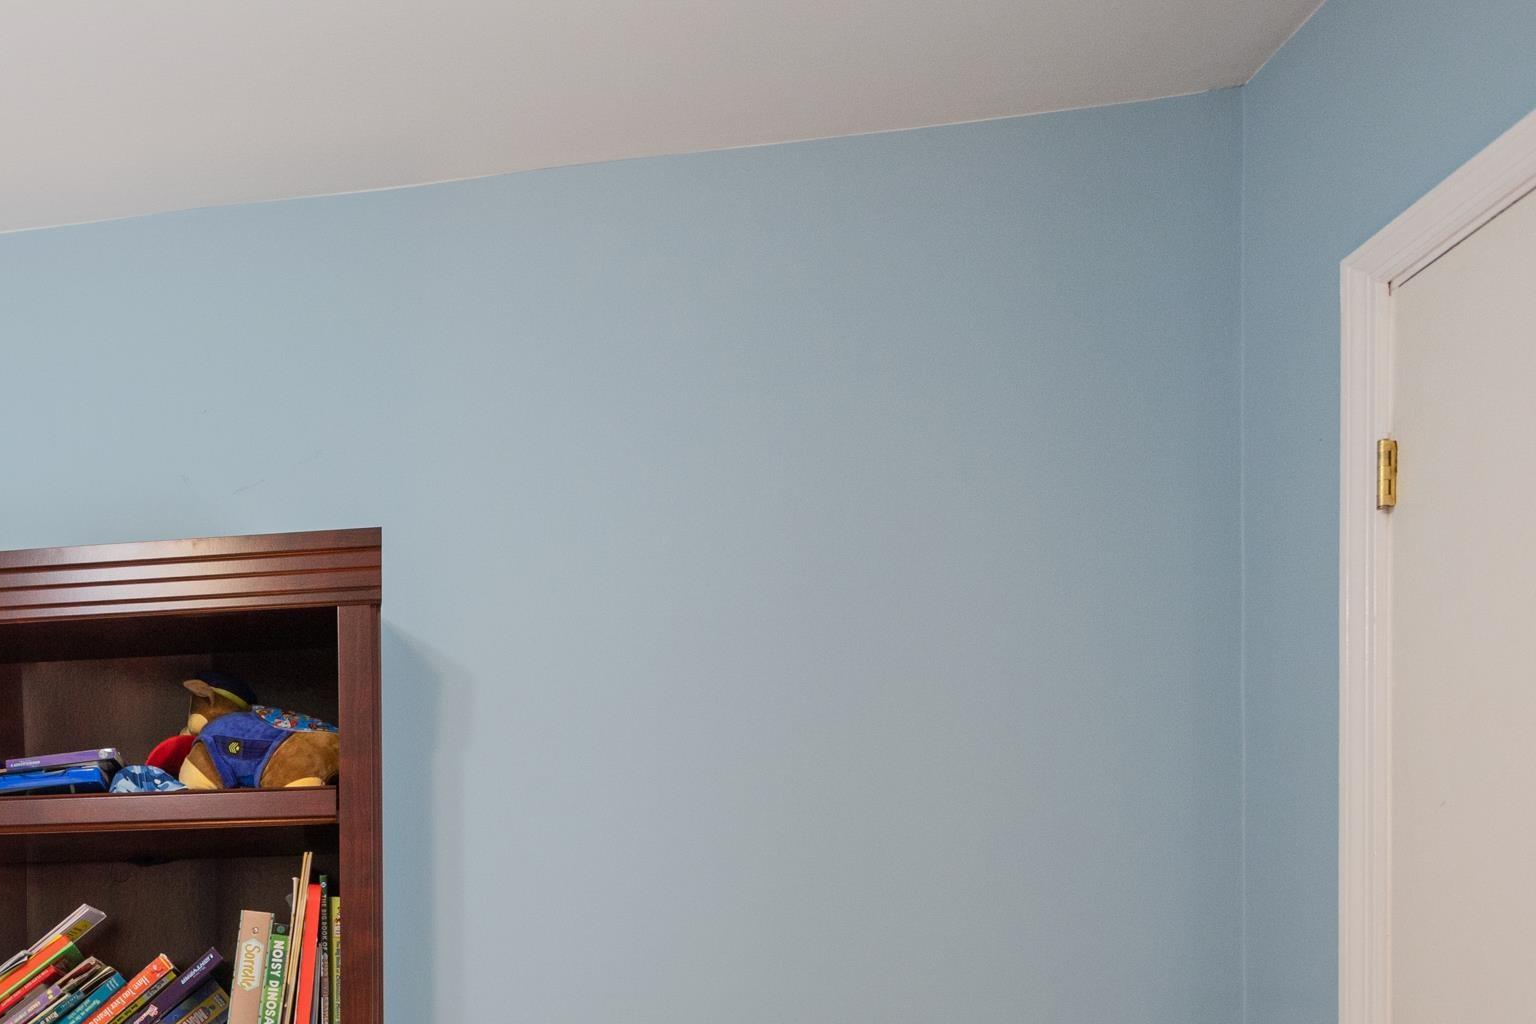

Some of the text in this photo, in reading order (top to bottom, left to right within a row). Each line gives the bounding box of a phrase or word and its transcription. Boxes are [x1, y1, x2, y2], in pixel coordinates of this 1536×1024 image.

[269, 939, 285, 976] NOISY
[131, 975, 149, 992] Have
[122, 987, 136, 1000] You
[109, 996, 125, 1011] Ever
